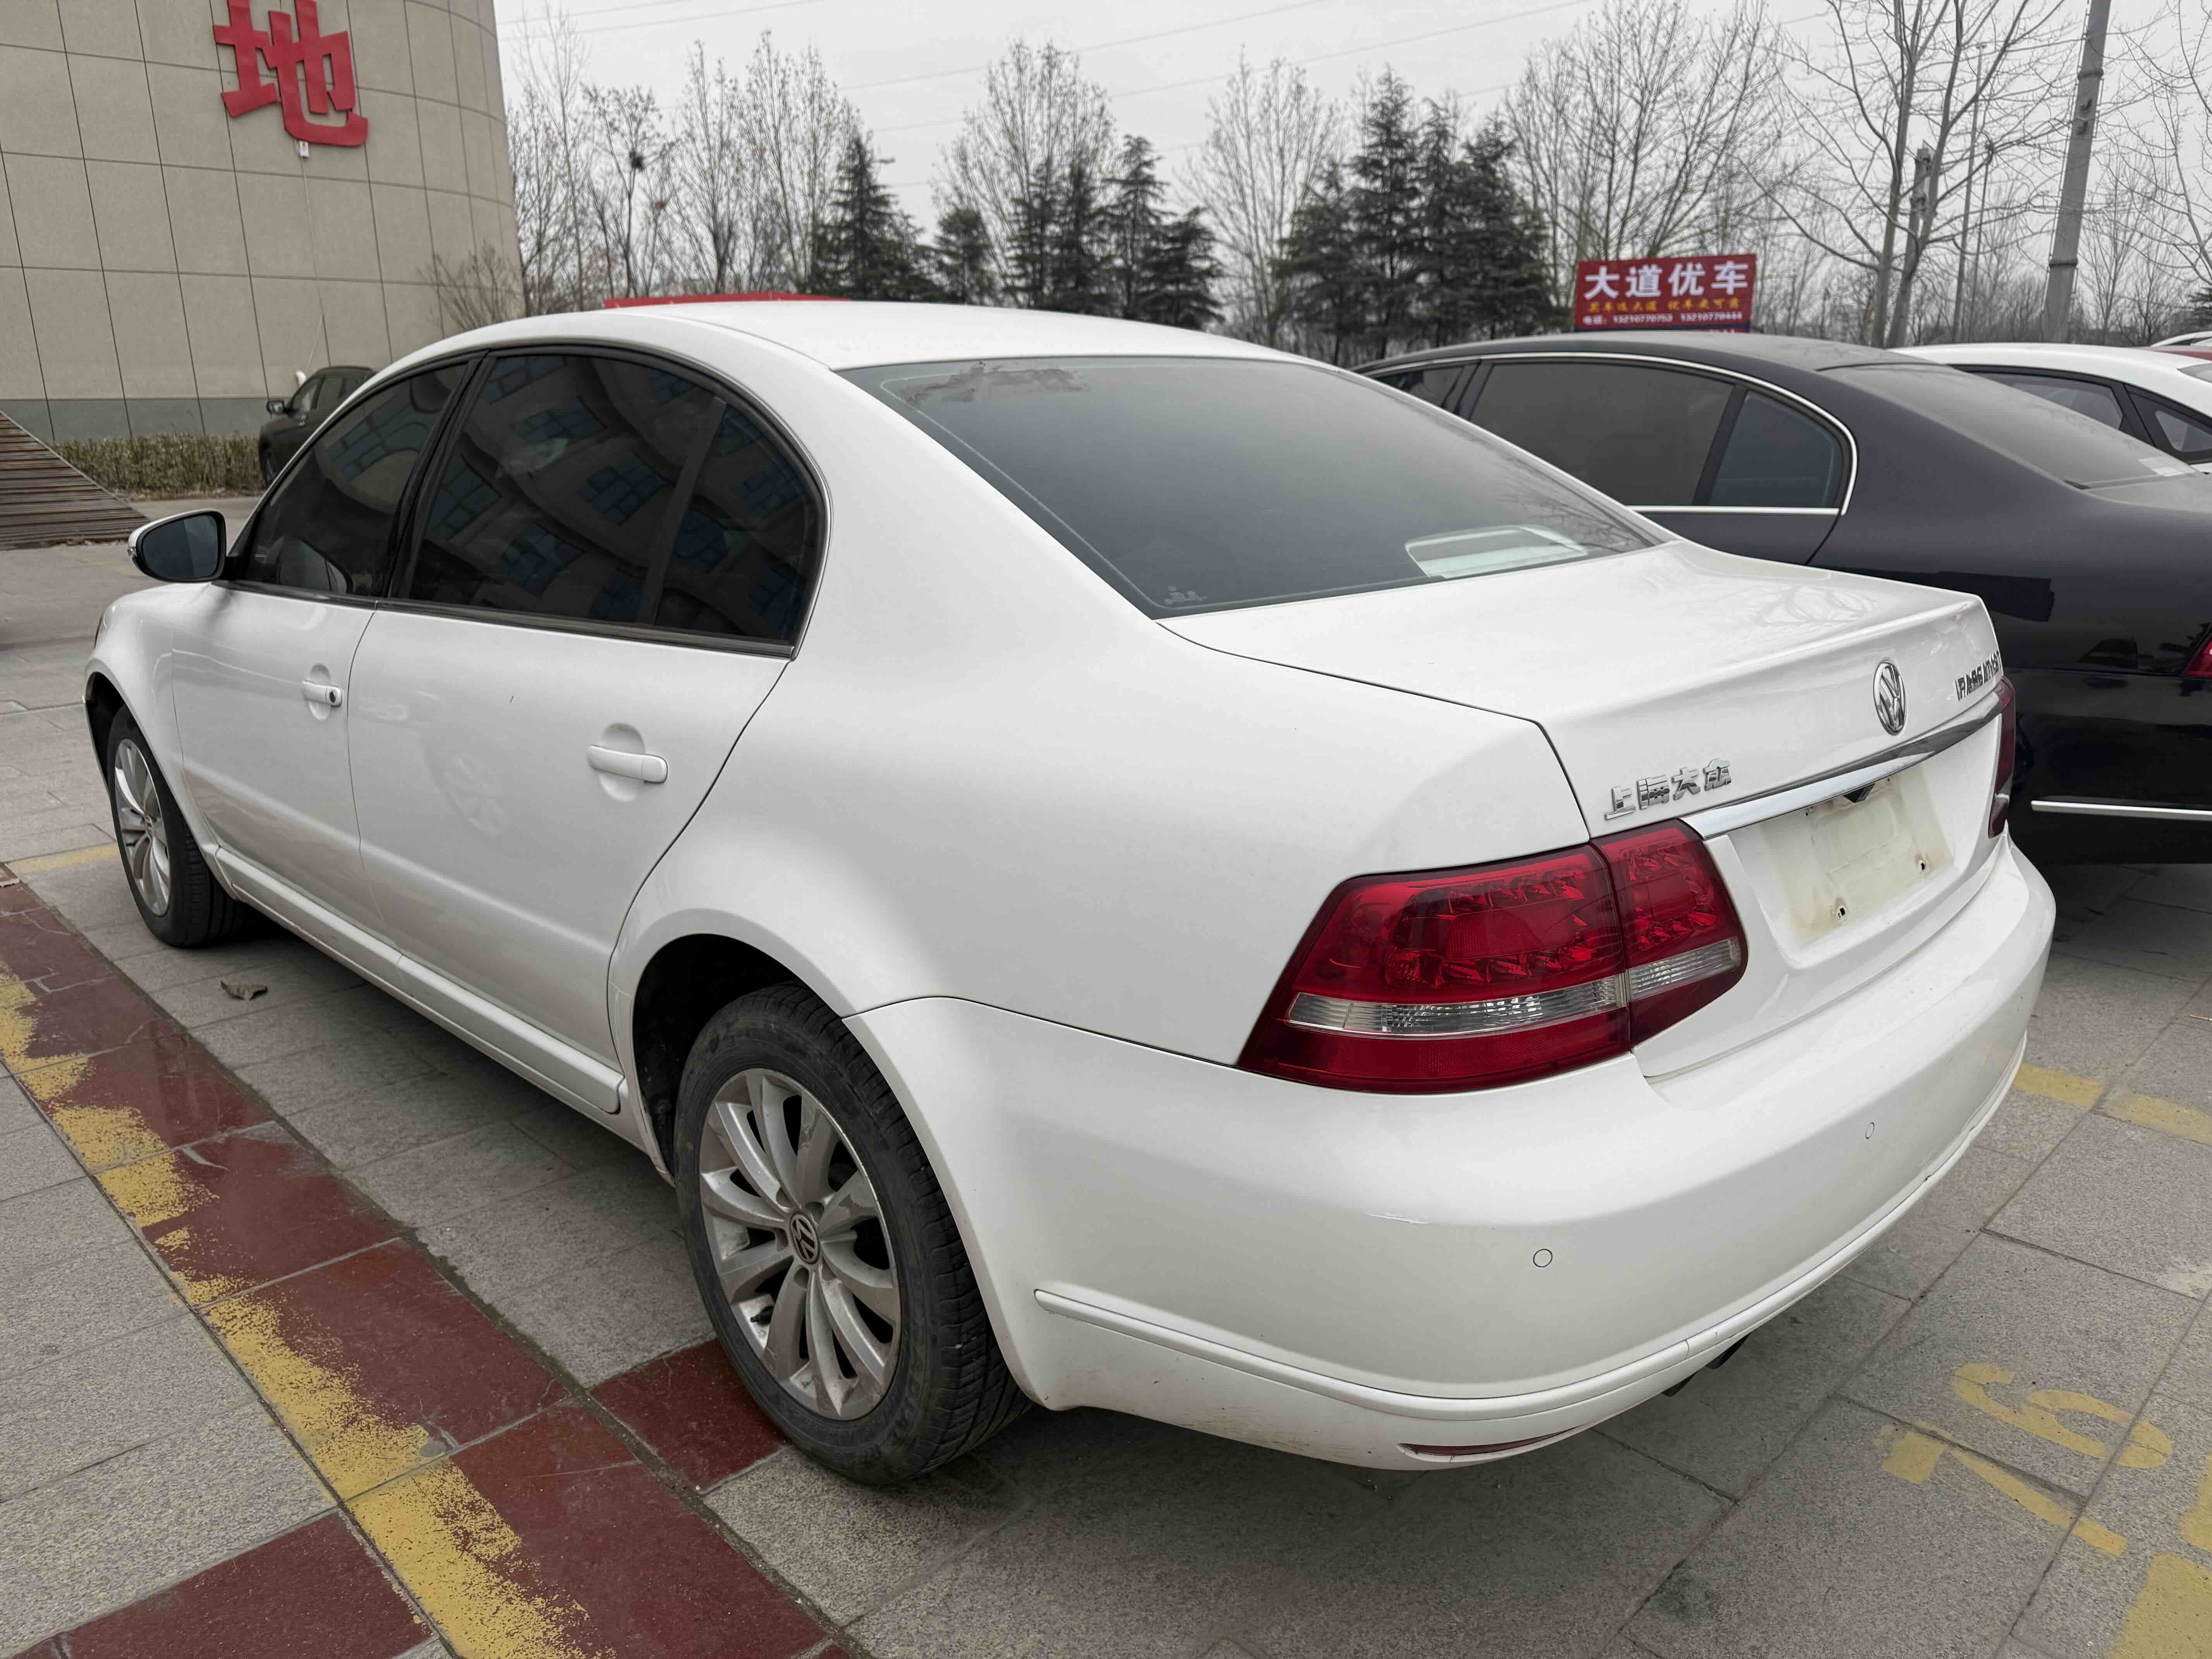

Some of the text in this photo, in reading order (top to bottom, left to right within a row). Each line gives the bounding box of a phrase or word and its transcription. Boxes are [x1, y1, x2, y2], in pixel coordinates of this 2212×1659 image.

[213, 0, 368, 147] 地
[1584, 260, 1748, 300] 大道优车
[1604, 758, 1732, 821] 上海大众
